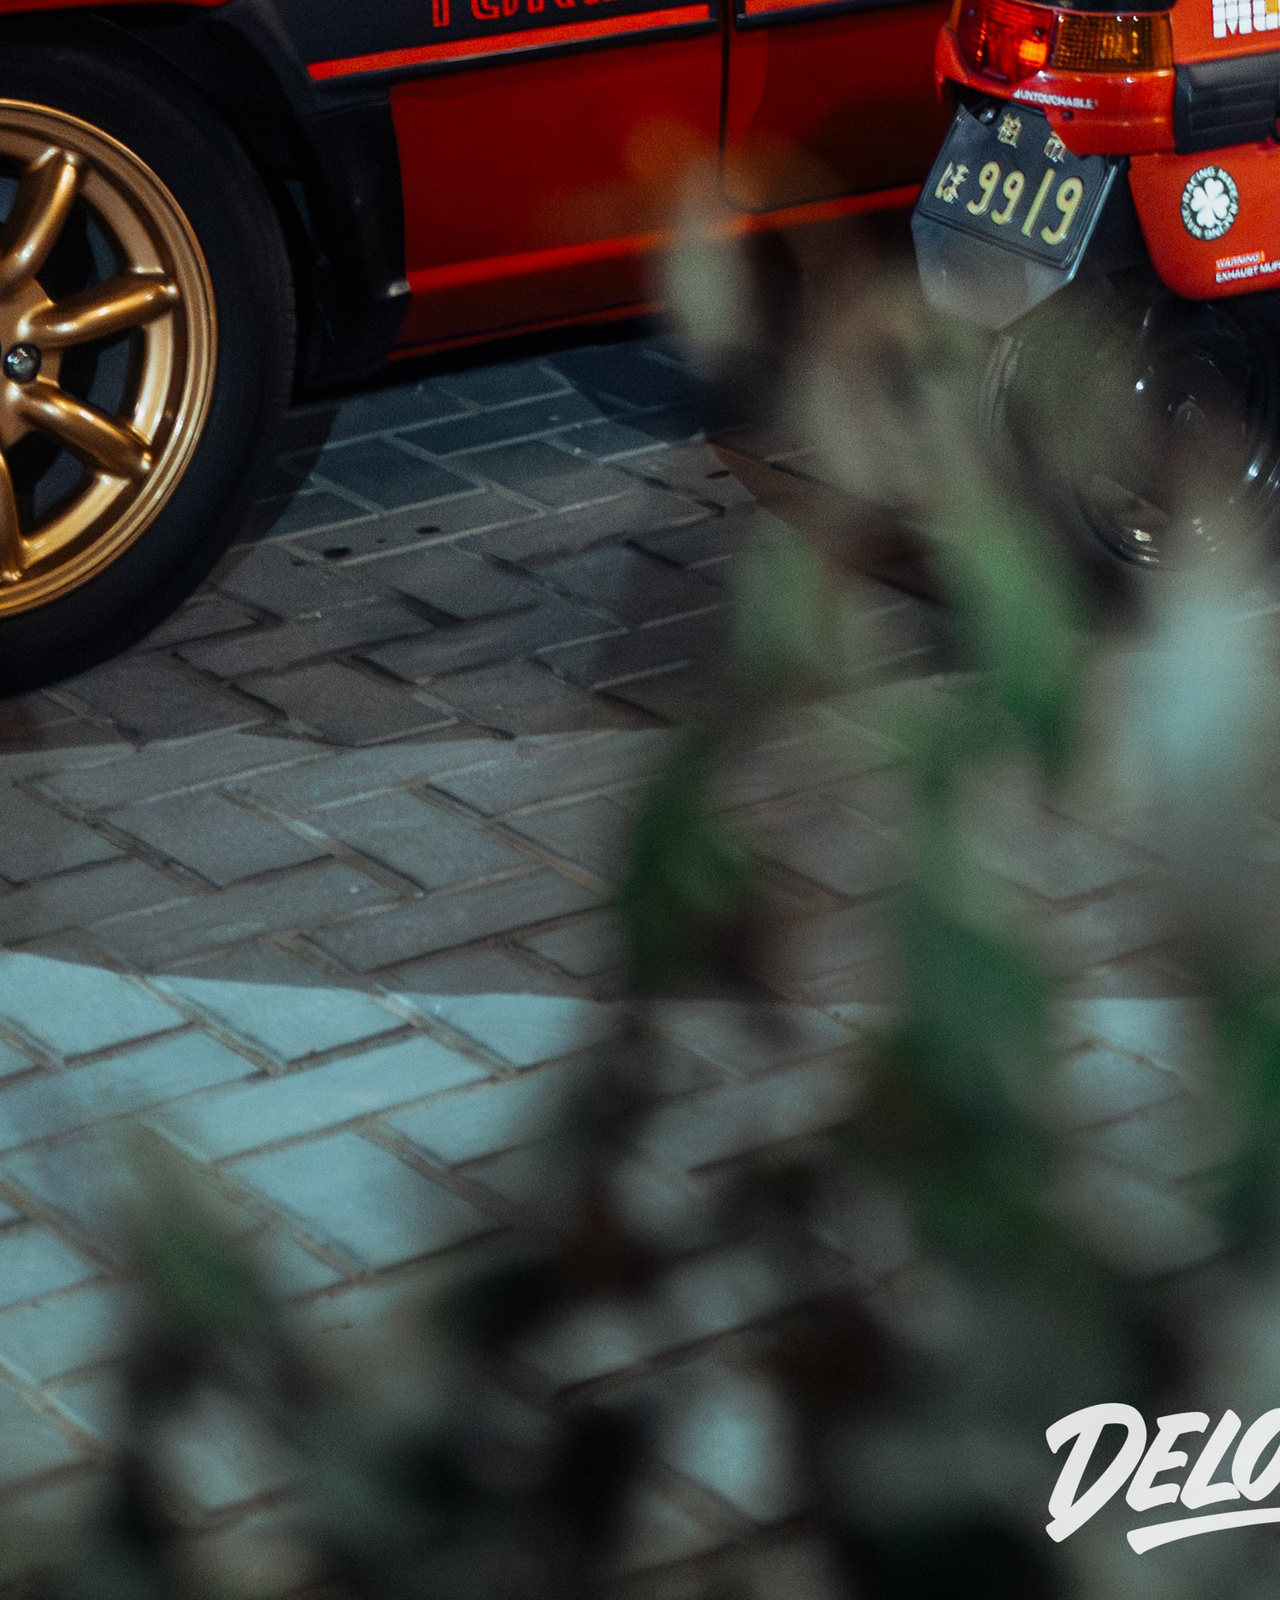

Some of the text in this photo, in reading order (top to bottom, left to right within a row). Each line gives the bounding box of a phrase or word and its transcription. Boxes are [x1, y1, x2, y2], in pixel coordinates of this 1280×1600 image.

[966, 161, 1084, 245] 9919
[1216, 252, 1260, 269] WARNING
[1215, 265, 1259, 284] EXHAUST
